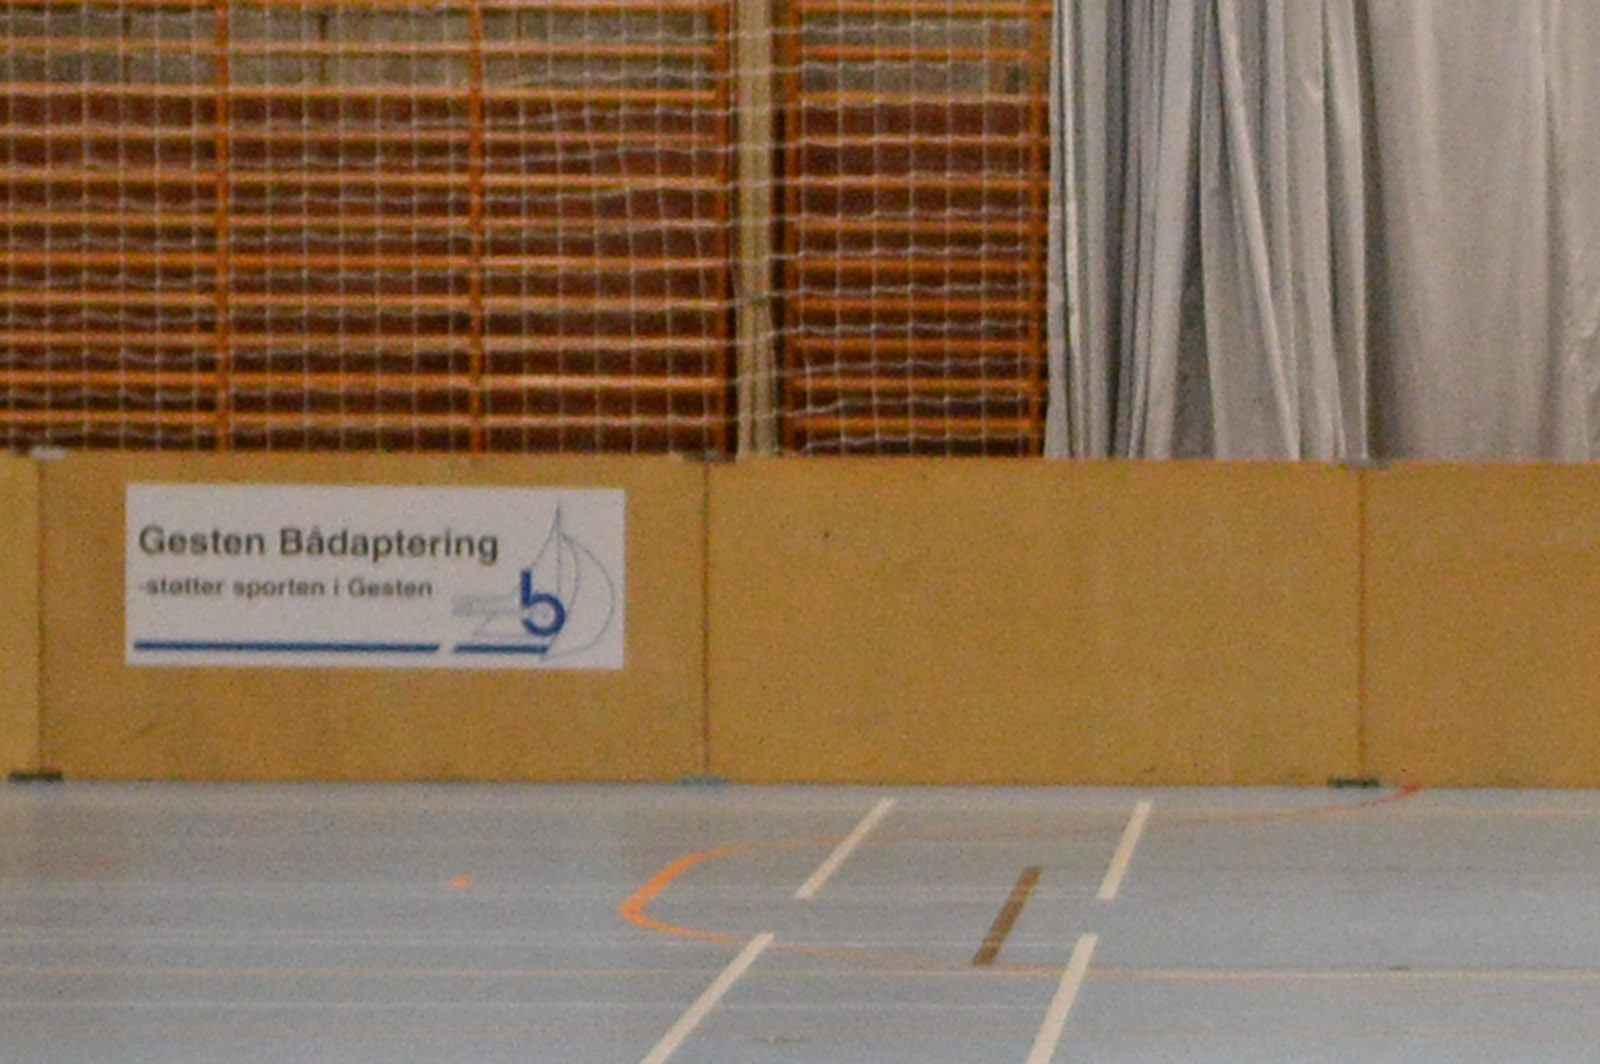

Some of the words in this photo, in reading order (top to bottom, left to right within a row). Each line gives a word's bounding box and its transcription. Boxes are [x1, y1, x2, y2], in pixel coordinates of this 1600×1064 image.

[138, 524, 265, 556] Gesten
[279, 525, 499, 566] Bådaptering
[232, 577, 326, 599] sporten
[332, 577, 340, 597] i
[347, 577, 433, 597] Gesten
